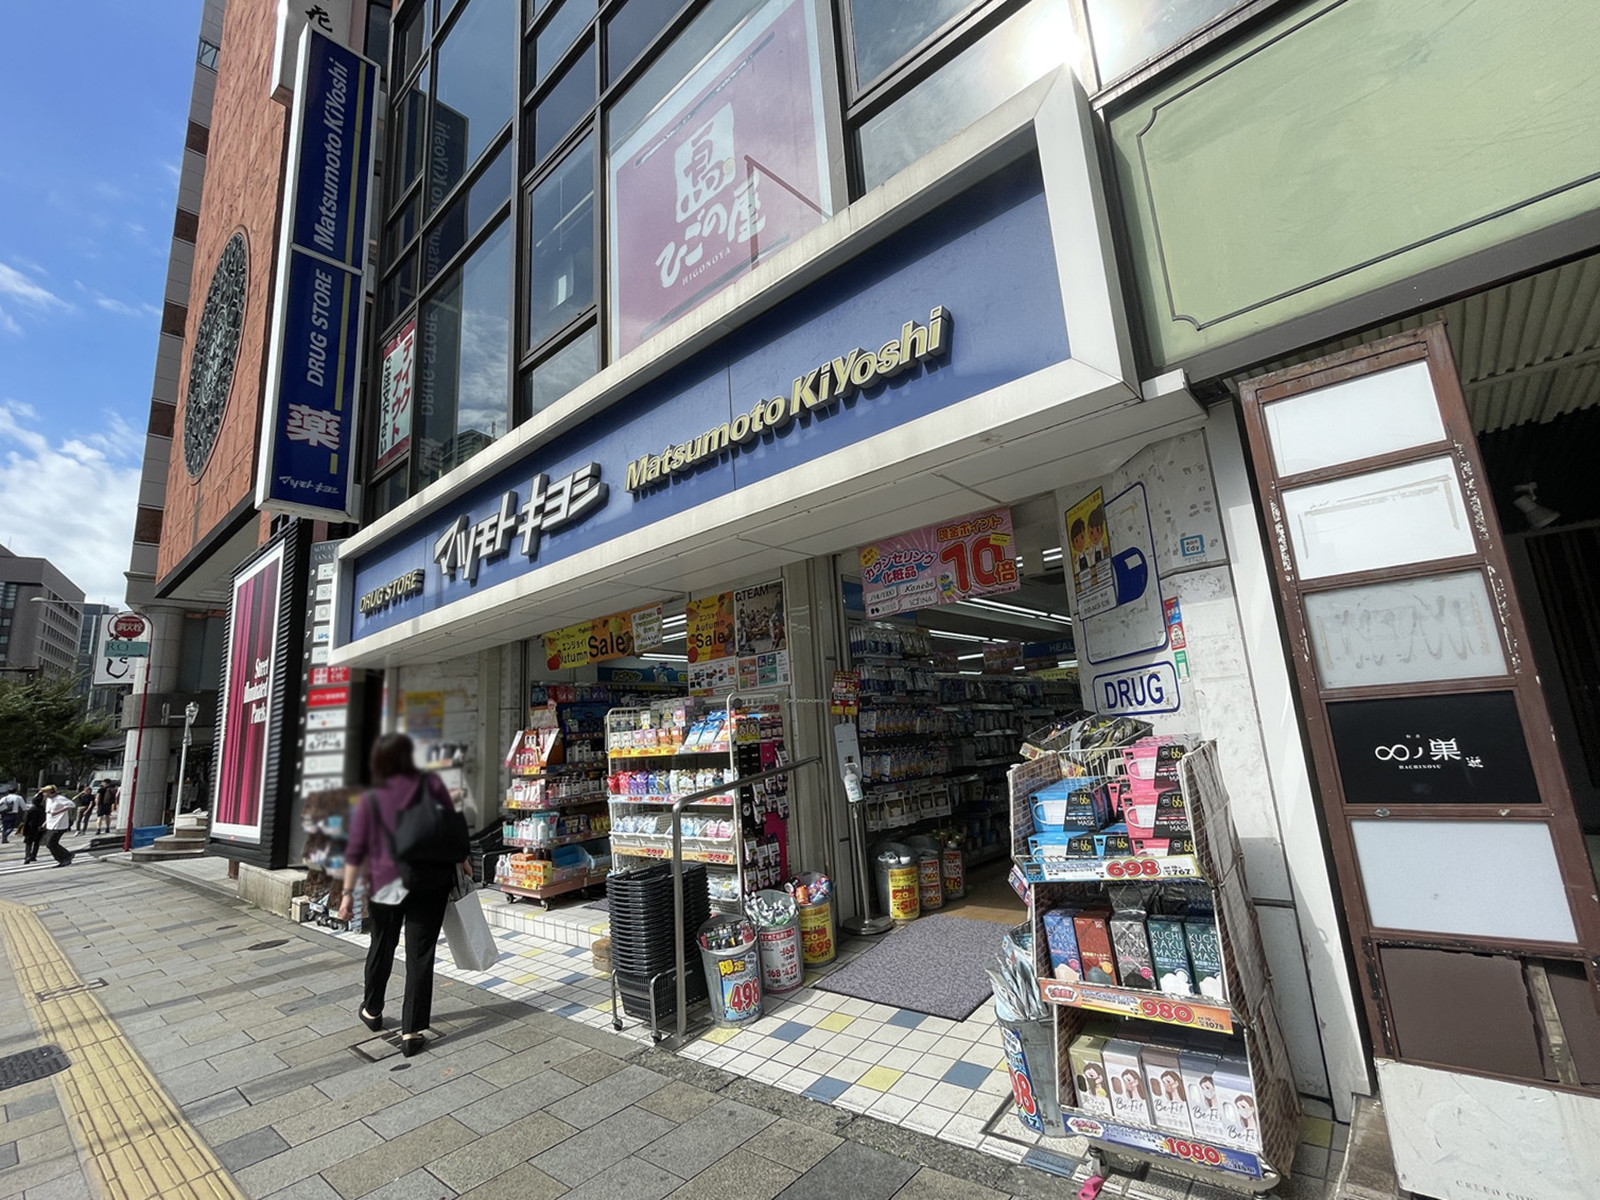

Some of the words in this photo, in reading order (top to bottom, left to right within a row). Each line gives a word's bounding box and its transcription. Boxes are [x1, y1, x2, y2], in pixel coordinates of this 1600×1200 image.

[324, 57, 349, 134] KiYoshi
[313, 131, 342, 251] Matsumoto
[682, 247, 731, 286] HIGONOYA
[312, 269, 333, 331] STORE
[307, 331, 328, 387] DRUG
[625, 396, 790, 493] Matsumoto
[789, 305, 953, 416] KiYoshi
[286, 403, 342, 450] 薬
[434, 461, 608, 580] マツモトキヨシ
[938, 515, 1002, 542] 現金ポイント
[865, 551, 936, 579] カウンセリング
[883, 565, 917, 584] 化粧品
[940, 536, 1005, 593] 10
[994, 559, 1017, 584] 倍
[359, 588, 385, 613] DRUG
[384, 569, 424, 599] STORE
[117, 622, 143, 631] 消火栓
[696, 630, 725, 648] Sale
[560, 651, 588, 664] utumn
[588, 632, 626, 658] Sale
[1104, 674, 1164, 709] DRUG
[1107, 859, 1161, 878] 698
[1151, 930, 1182, 940] KUCHI
[1152, 939, 1184, 950] RAKU
[1154, 949, 1186, 960] MASK
[731, 977, 760, 1012] 498
[1140, 999, 1195, 1024] 980
[1115, 1098, 1143, 1112] Be-Fit
[1154, 1098, 1184, 1113] Be-Fit
[1193, 1106, 1222, 1122] Be-Fi
[1227, 1125, 1258, 1140] Be-Fi
[1165, 1137, 1220, 1165] 1080
